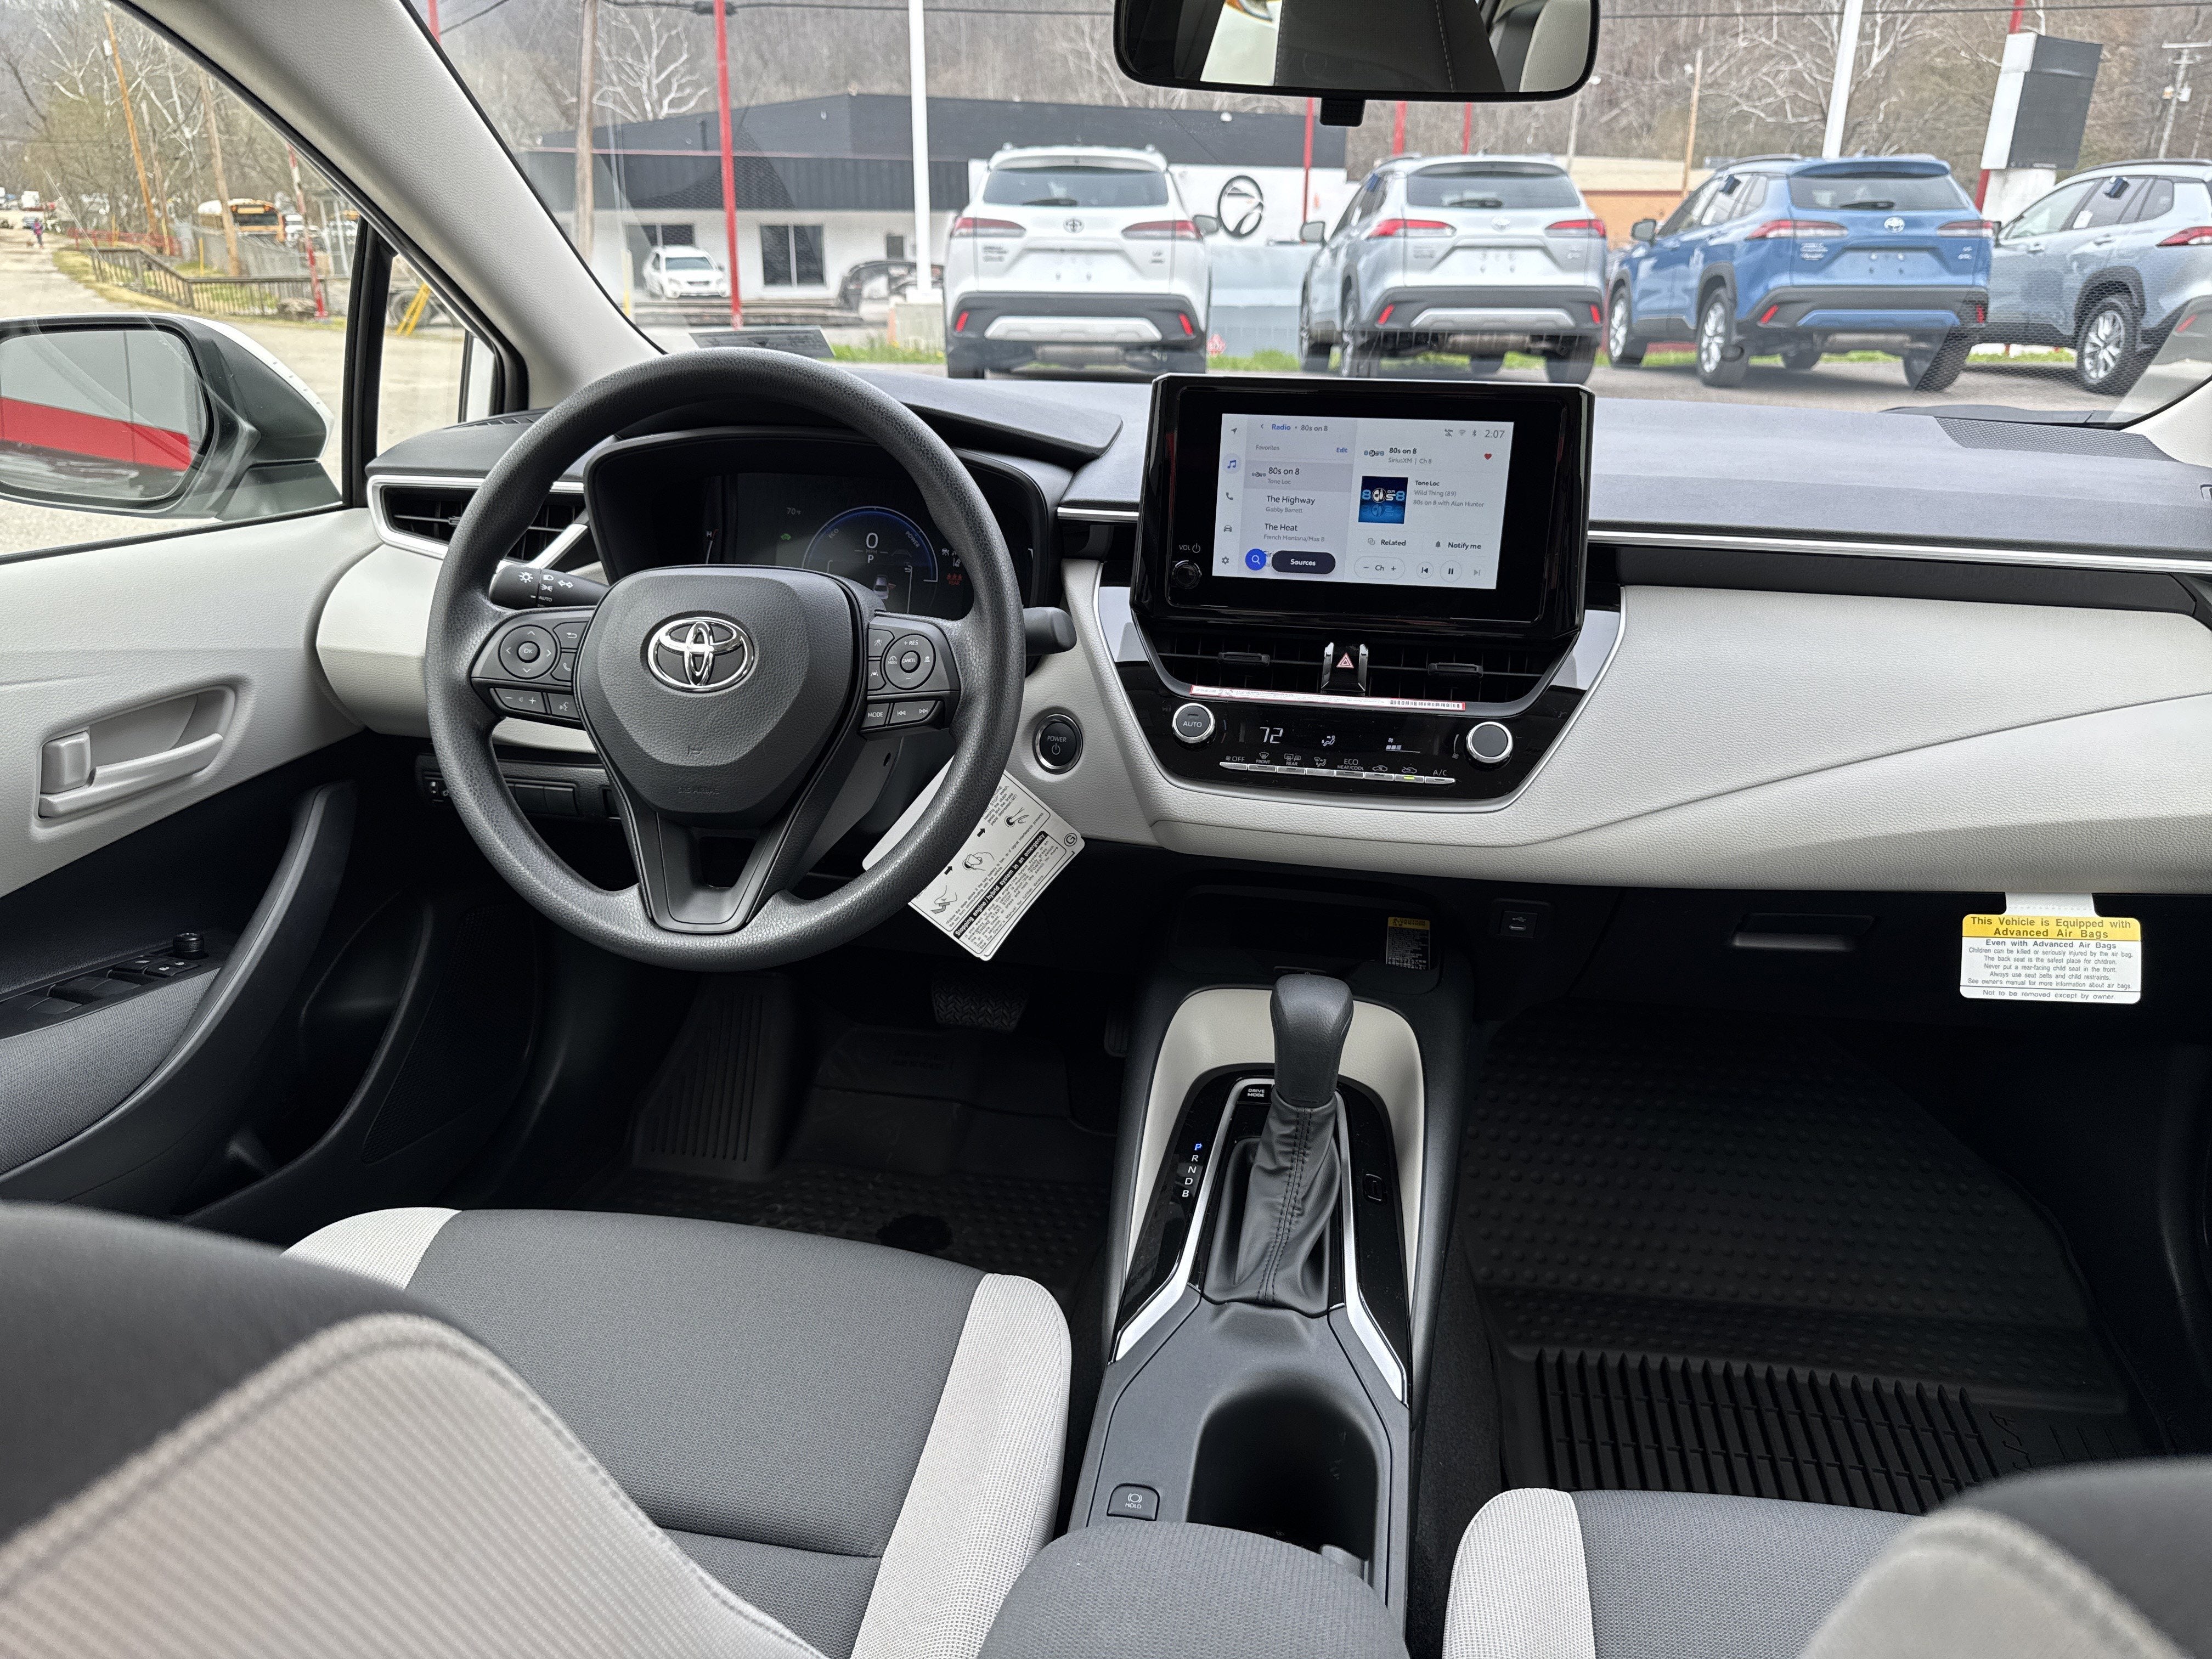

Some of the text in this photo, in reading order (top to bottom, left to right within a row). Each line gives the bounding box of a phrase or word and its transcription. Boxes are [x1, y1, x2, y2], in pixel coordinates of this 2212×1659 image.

[1485, 430, 1505, 438] 2:07
[1268, 467, 1281, 475] 80s
[1282, 496, 1316, 506] Highway
[828, 528, 839, 539] ECO
[866, 532, 878, 549] 0
[905, 531, 920, 548] POWER
[1448, 542, 1469, 550] Notify
[867, 554, 874, 563] P
[1260, 726, 1284, 744] 72
[954, 915, 974, 936] Stopping
[998, 868, 1015, 887] system
[1023, 833, 1046, 857] emergency
[1970, 916, 2131, 929] This Vehicle is Equipped with
[1993, 927, 2108, 939] Advanced Air Bags
[2032, 940, 2074, 948] Advanced
[2095, 941, 2116, 950] Bags
[1188, 1166, 1197, 1174] N
[1184, 1177, 1193, 1186] D
[1182, 1190, 1189, 1198] B
